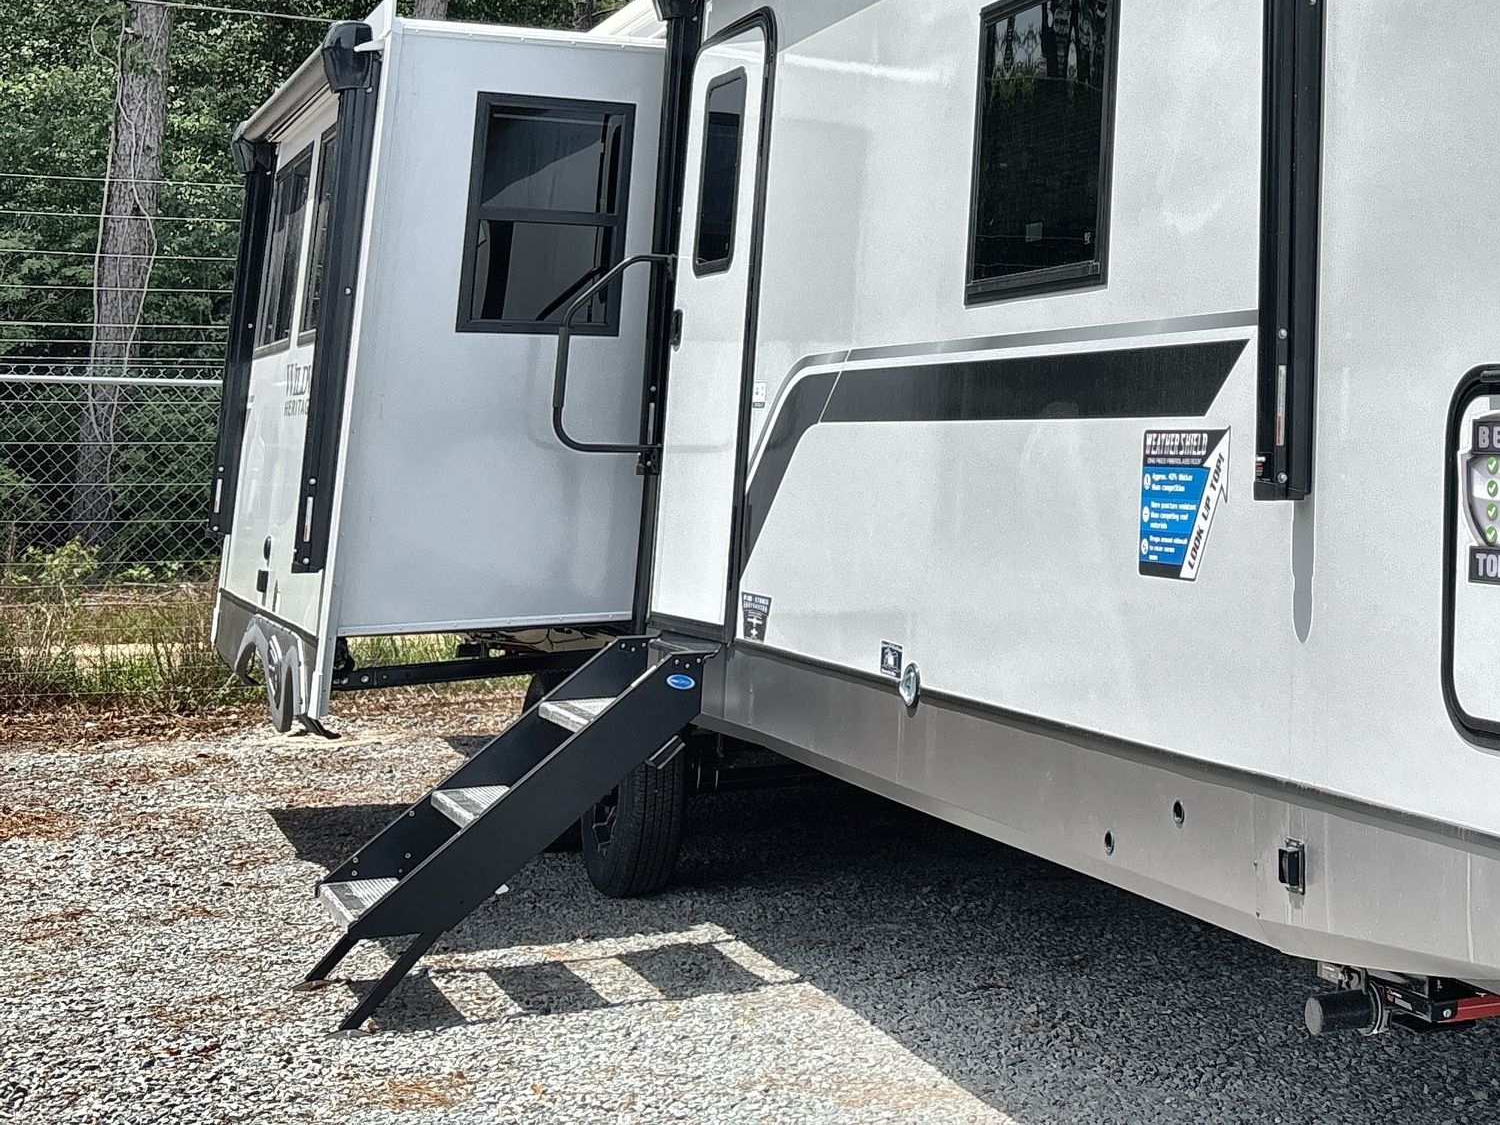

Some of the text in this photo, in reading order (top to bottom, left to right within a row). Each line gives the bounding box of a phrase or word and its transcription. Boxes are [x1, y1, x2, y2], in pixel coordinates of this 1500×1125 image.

[284, 399, 310, 416] HERITAG
[1145, 433, 1208, 456] WEATHER SHIELD
[1188, 452, 1225, 570] LOOK UP TOP!
